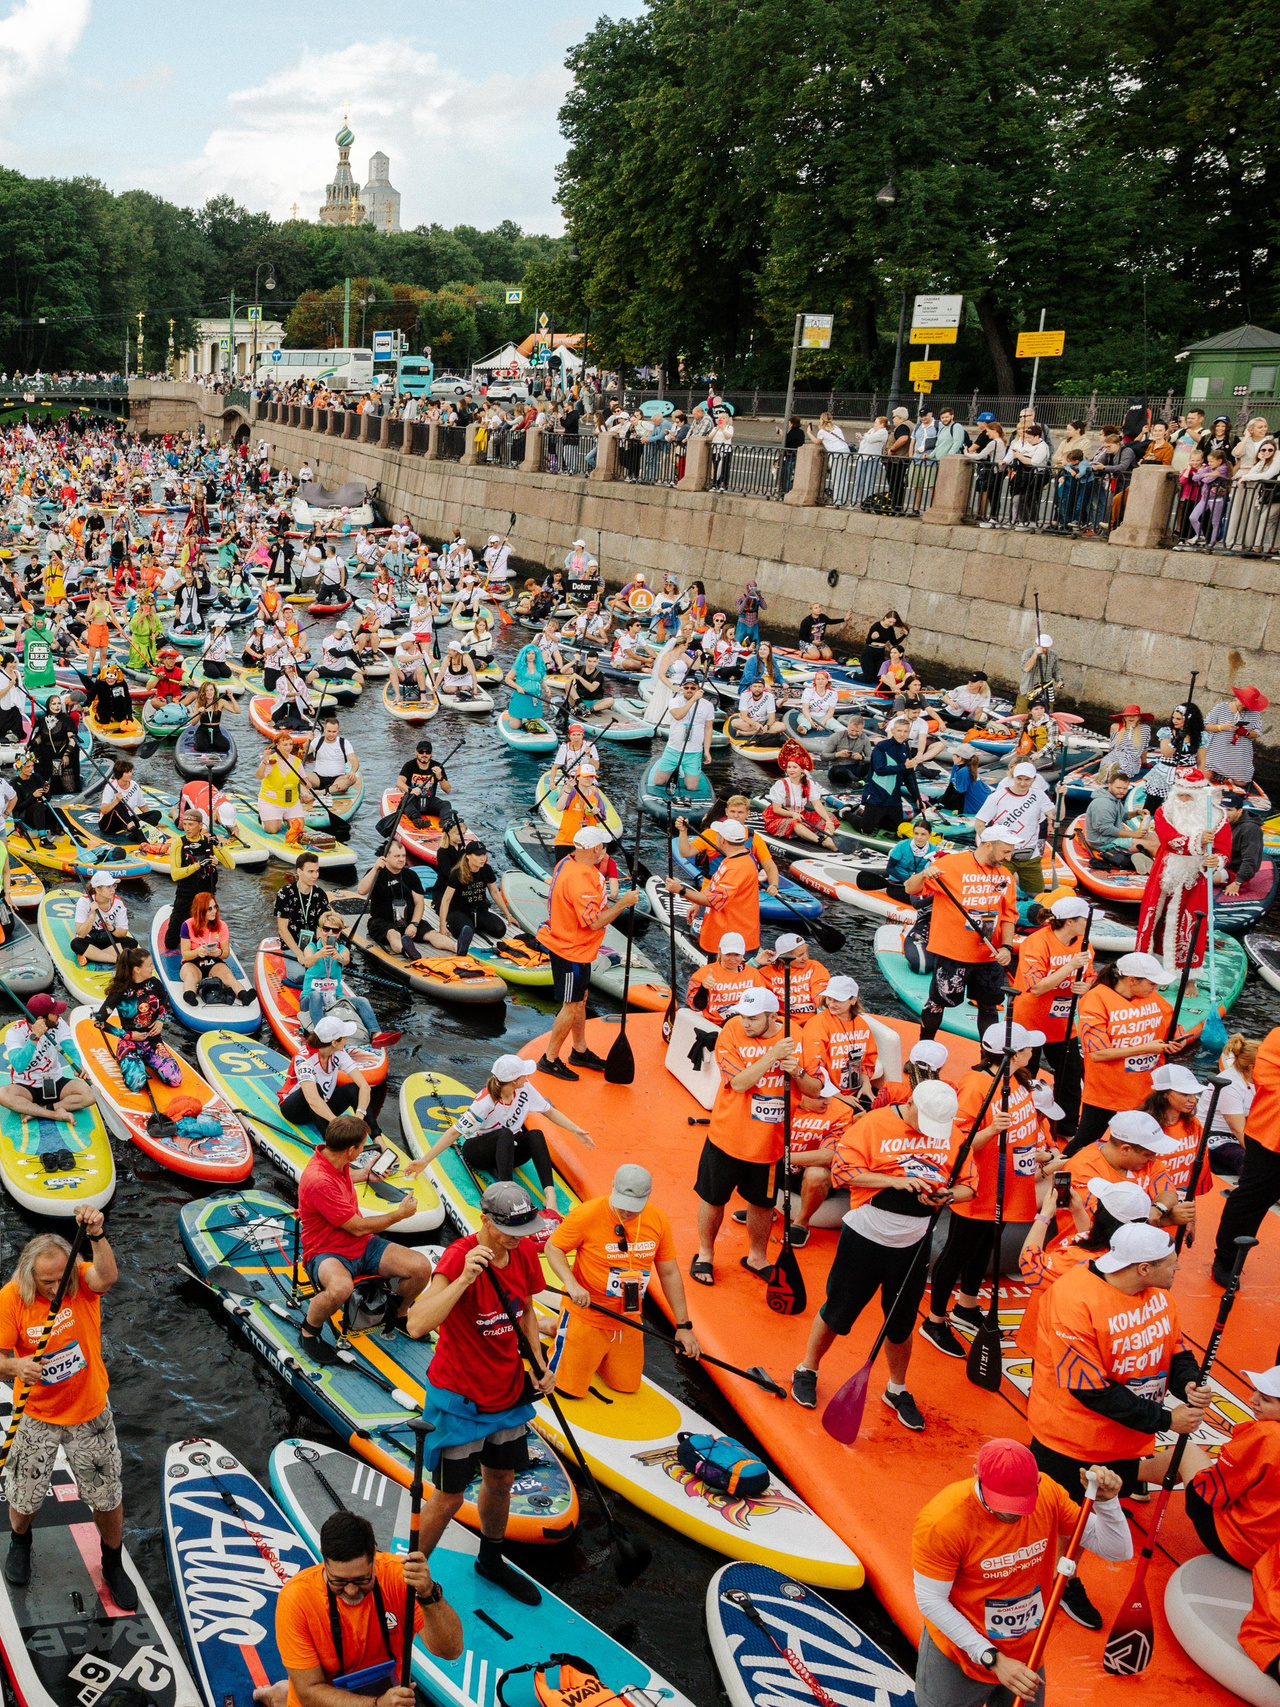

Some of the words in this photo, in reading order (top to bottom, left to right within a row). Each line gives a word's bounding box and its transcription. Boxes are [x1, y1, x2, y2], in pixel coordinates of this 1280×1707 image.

[962, 873, 1012, 884] КОМАНДА
[962, 895, 1002, 906] НЕФТИ
[200, 959, 215, 967] FILA
[1108, 1292, 1168, 1335] КОМАНДА
[979, 1344, 990, 1377] ITIWIT
[1207, 1333, 1222, 1366] MARINA
